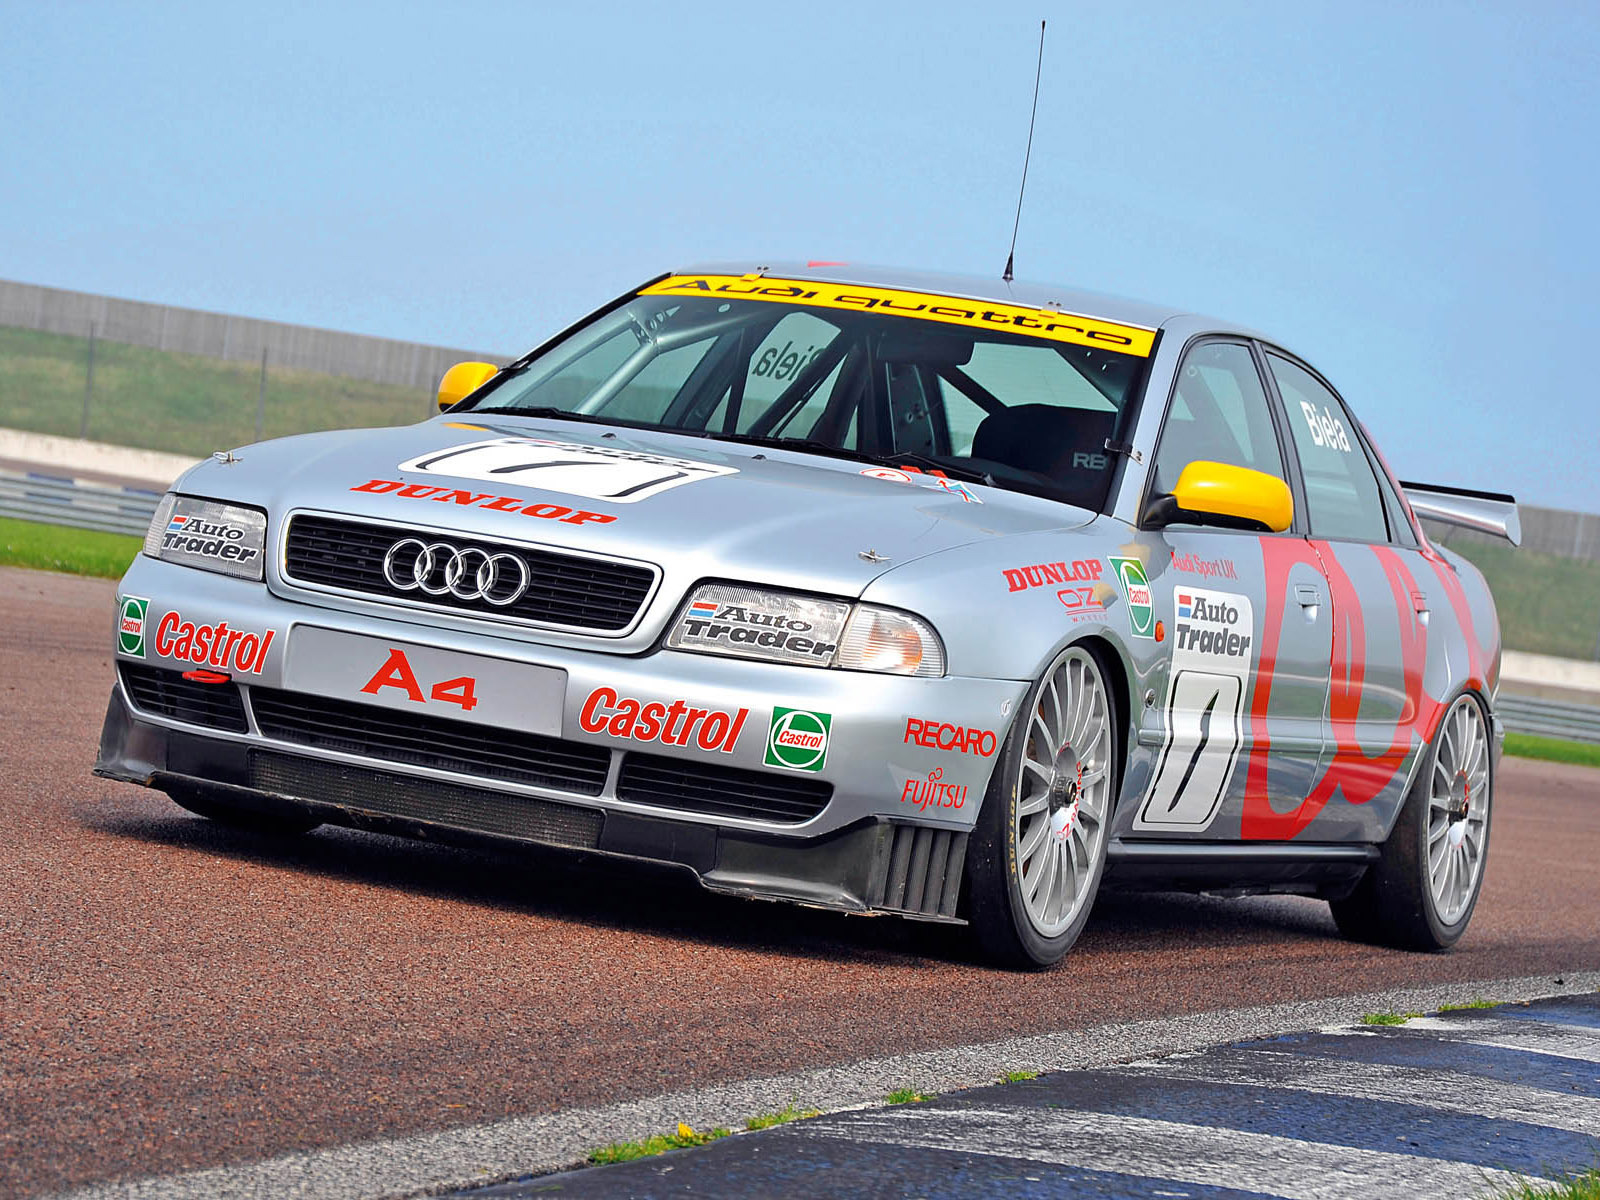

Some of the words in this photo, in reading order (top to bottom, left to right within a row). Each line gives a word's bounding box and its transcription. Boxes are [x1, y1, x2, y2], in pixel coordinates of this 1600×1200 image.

[659, 280, 819, 299] Audi
[834, 294, 1132, 346] quattro
[1300, 400, 1351, 452] Biela
[349, 479, 618, 525] DUNLOP
[182, 518, 244, 540] Auto
[163, 533, 256, 563] Trader
[1002, 559, 1104, 593] DUNLOP
[1193, 553, 1223, 580] Sport
[1218, 559, 1239, 580] UK
[1128, 587, 1150, 605] Castrol
[1191, 596, 1239, 625] Auto
[121, 617, 142, 637] Castrol
[714, 605, 812, 632] Auto
[156, 611, 275, 674] Castrol
[685, 619, 836, 656] Trader
[1176, 623, 1251, 657] Trader
[361, 648, 477, 710] A4
[580, 687, 749, 752] Castrol
[778, 730, 824, 749] Castrol
[904, 718, 997, 757] RECARO
[900, 779, 968, 812] FUJITSU
